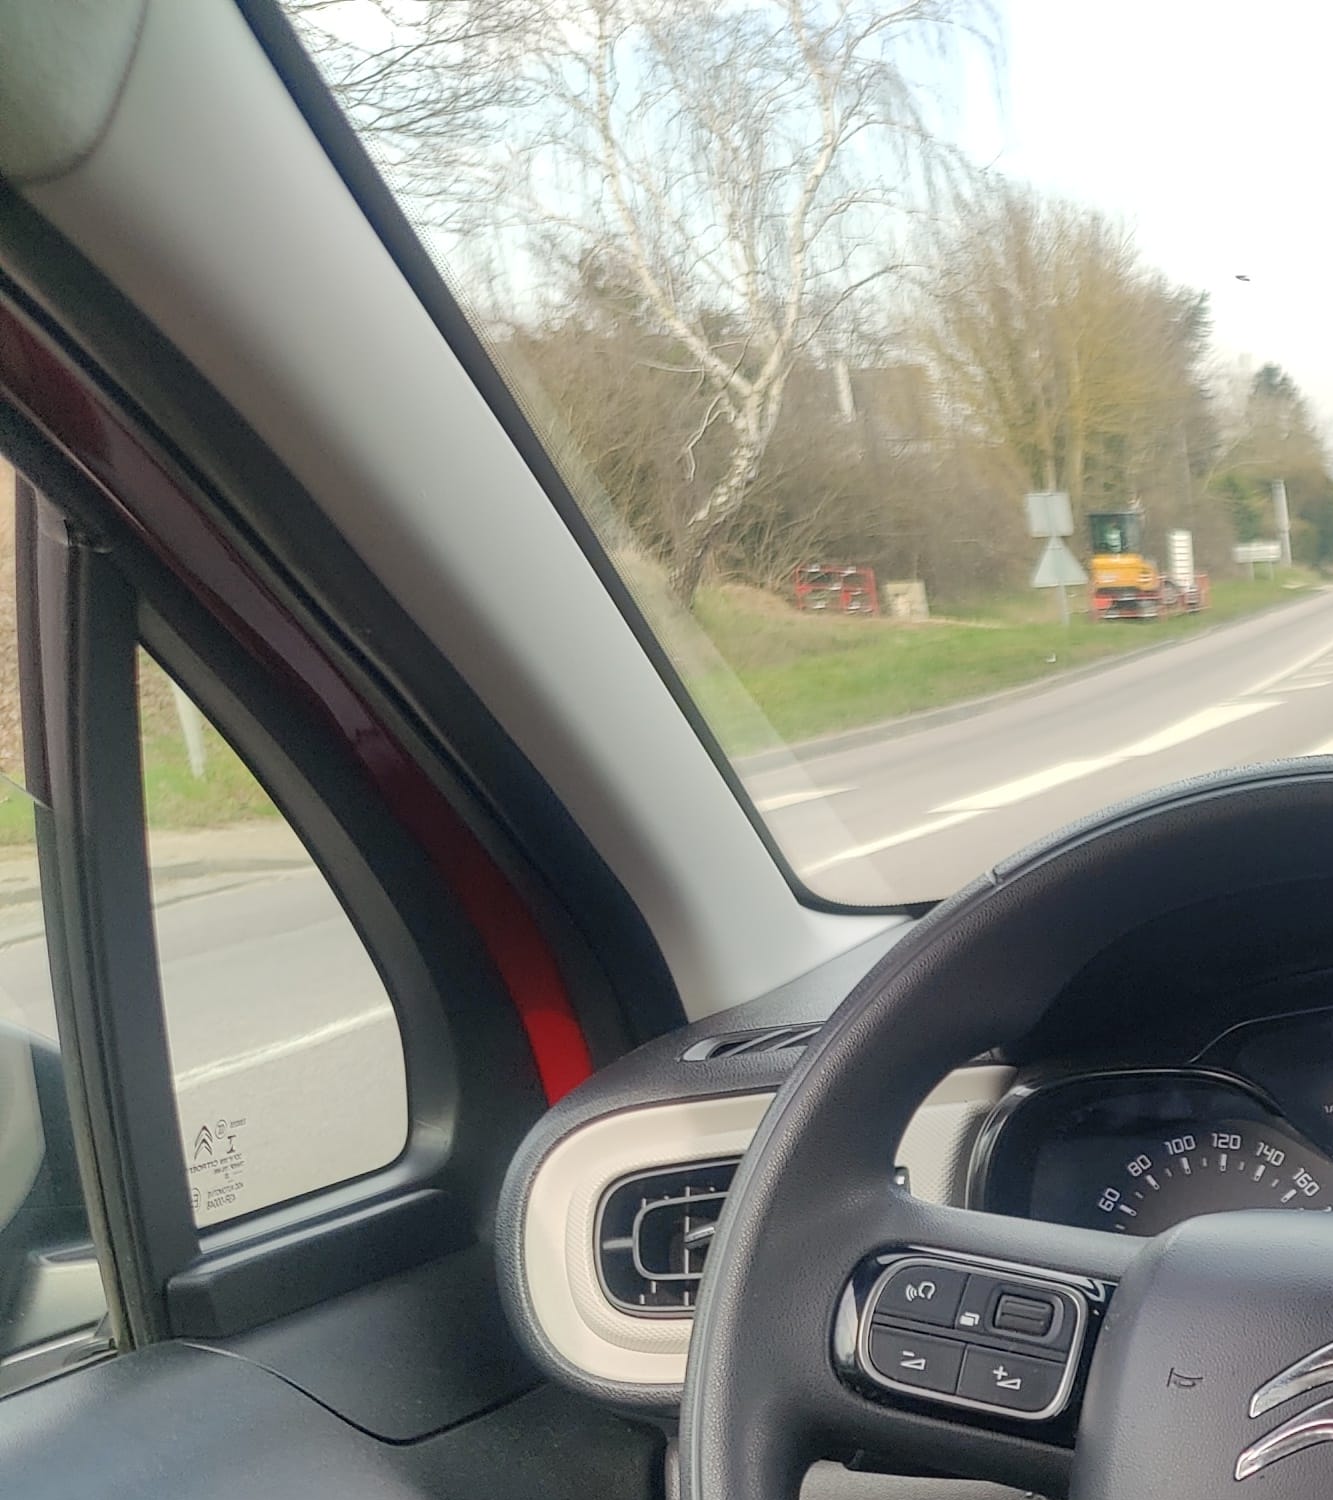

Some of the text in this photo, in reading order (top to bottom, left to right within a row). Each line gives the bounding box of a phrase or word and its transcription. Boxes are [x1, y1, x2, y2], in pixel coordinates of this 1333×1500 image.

[1164, 1135, 1196, 1155] 100
[1211, 1133, 1241, 1150] 120
[1127, 1154, 1152, 1177] 80
[1256, 1142, 1285, 1166] 140
[1292, 1167, 1320, 1197] 160
[1098, 1187, 1121, 1212] 60
